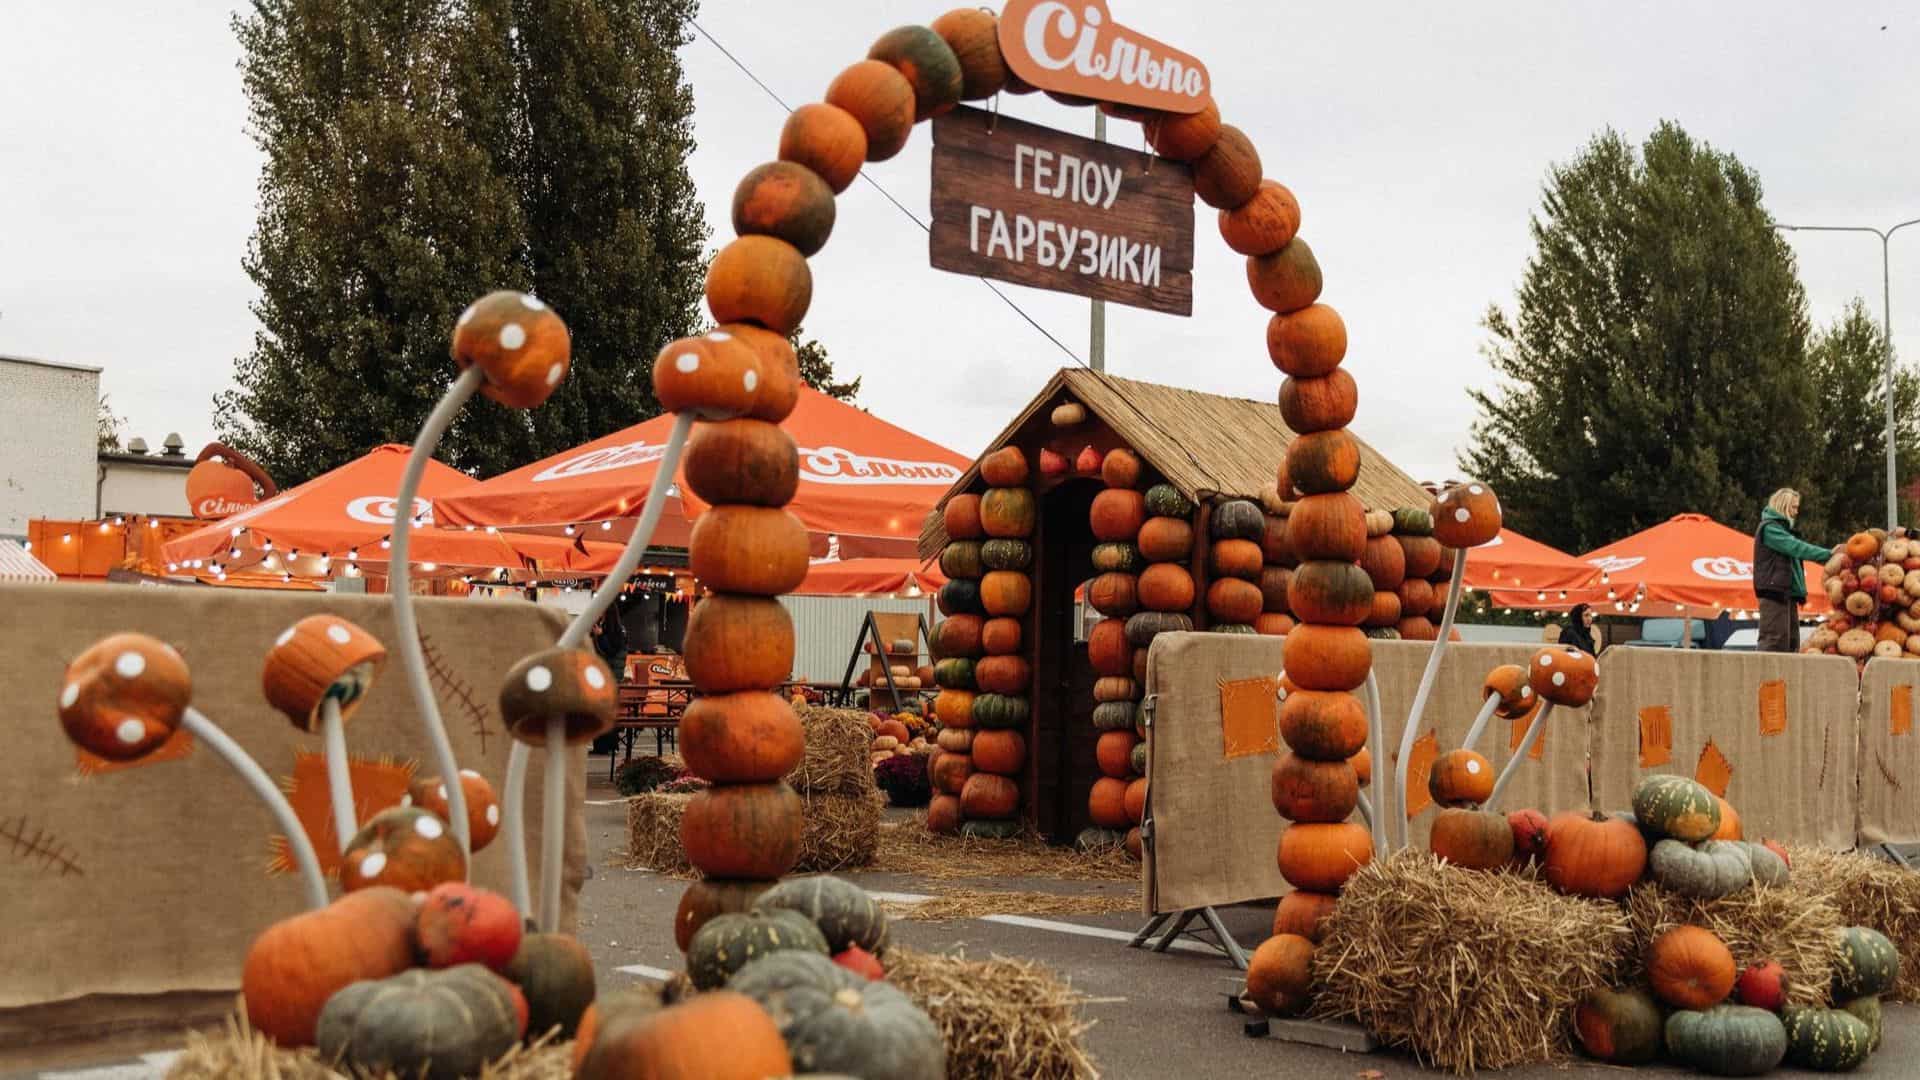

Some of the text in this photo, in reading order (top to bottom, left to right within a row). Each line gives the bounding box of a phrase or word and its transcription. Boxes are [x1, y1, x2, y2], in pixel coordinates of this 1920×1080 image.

[1024, 1, 1204, 97] Сільпо
[1014, 144, 1122, 210] ГЕЛОУ
[969, 205, 1161, 288] ГАРБУЗИКИ
